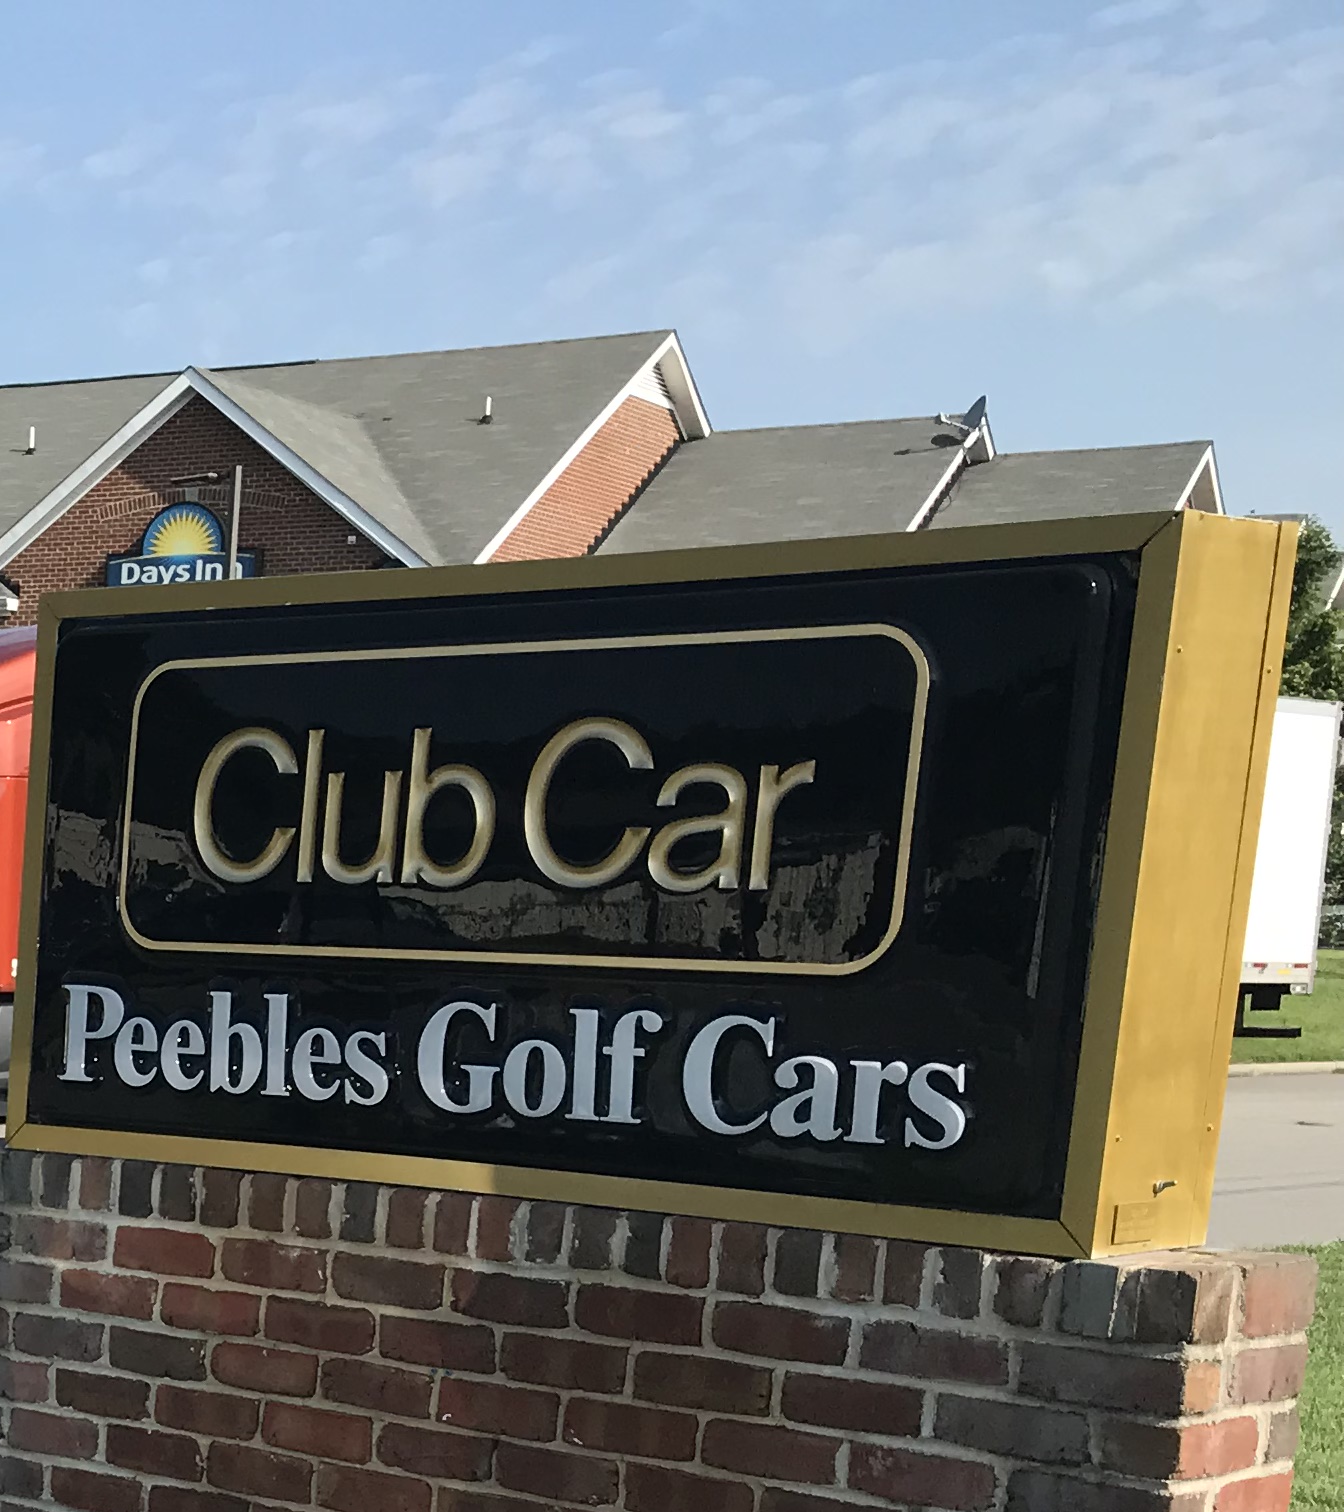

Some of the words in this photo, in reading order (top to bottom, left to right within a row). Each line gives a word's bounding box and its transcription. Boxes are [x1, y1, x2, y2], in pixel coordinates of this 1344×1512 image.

[120, 562, 190, 585] Days
[194, 727, 496, 887] Club
[524, 716, 816, 892] Car
[57, 984, 389, 1106] Peebles
[417, 1001, 663, 1124] Golf
[683, 1014, 967, 1150] Cars
